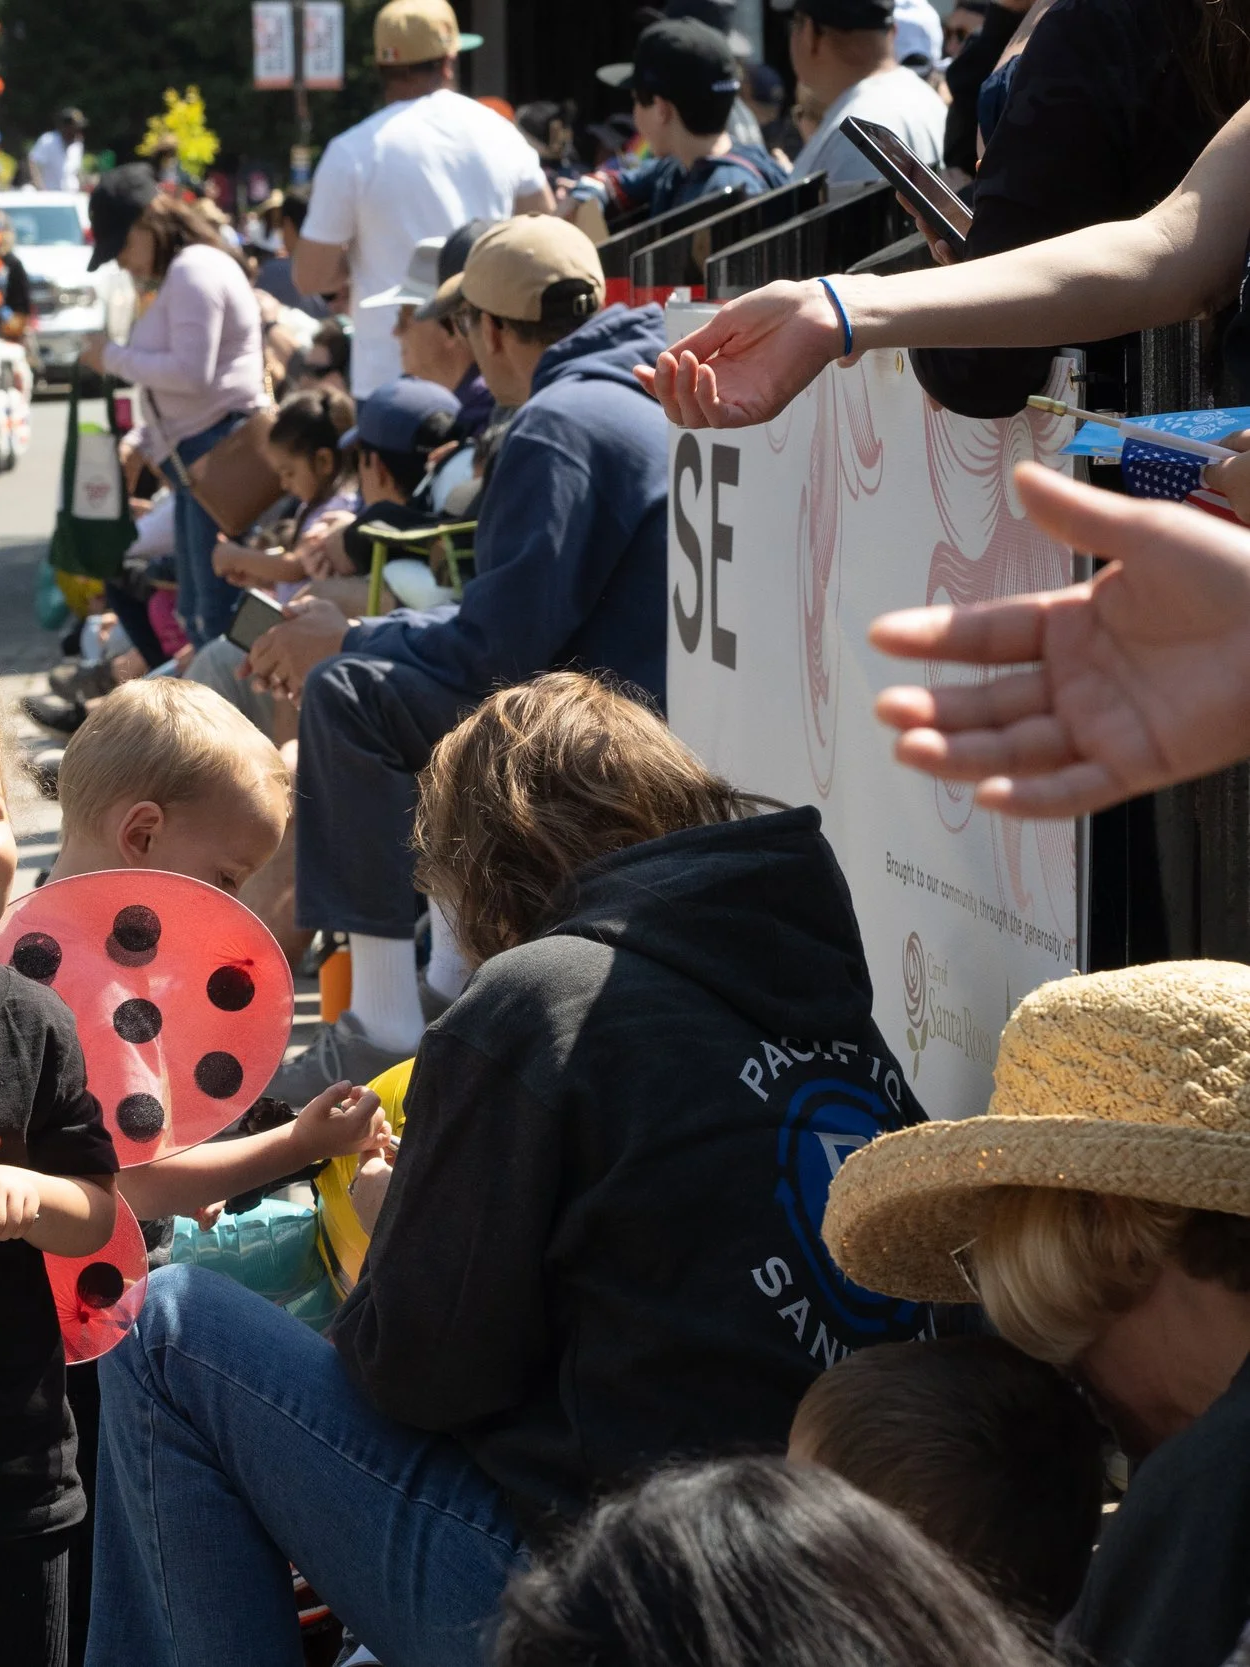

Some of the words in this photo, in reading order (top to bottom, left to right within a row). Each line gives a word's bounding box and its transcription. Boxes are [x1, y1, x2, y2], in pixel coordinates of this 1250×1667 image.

[673, 432, 740, 671] SE
[886, 851, 915, 887] Brought
[916, 865, 925, 888] to
[926, 874, 939, 894] our
[941, 879, 979, 919] community
[979, 894, 1008, 932] through
[1009, 909, 1022, 936] the
[1023, 921, 1062, 962] generosity
[926, 952, 942, 991] City
[942, 959, 949, 987] of
[928, 986, 964, 1051] Santa
[963, 1006, 993, 1065] Rosa
